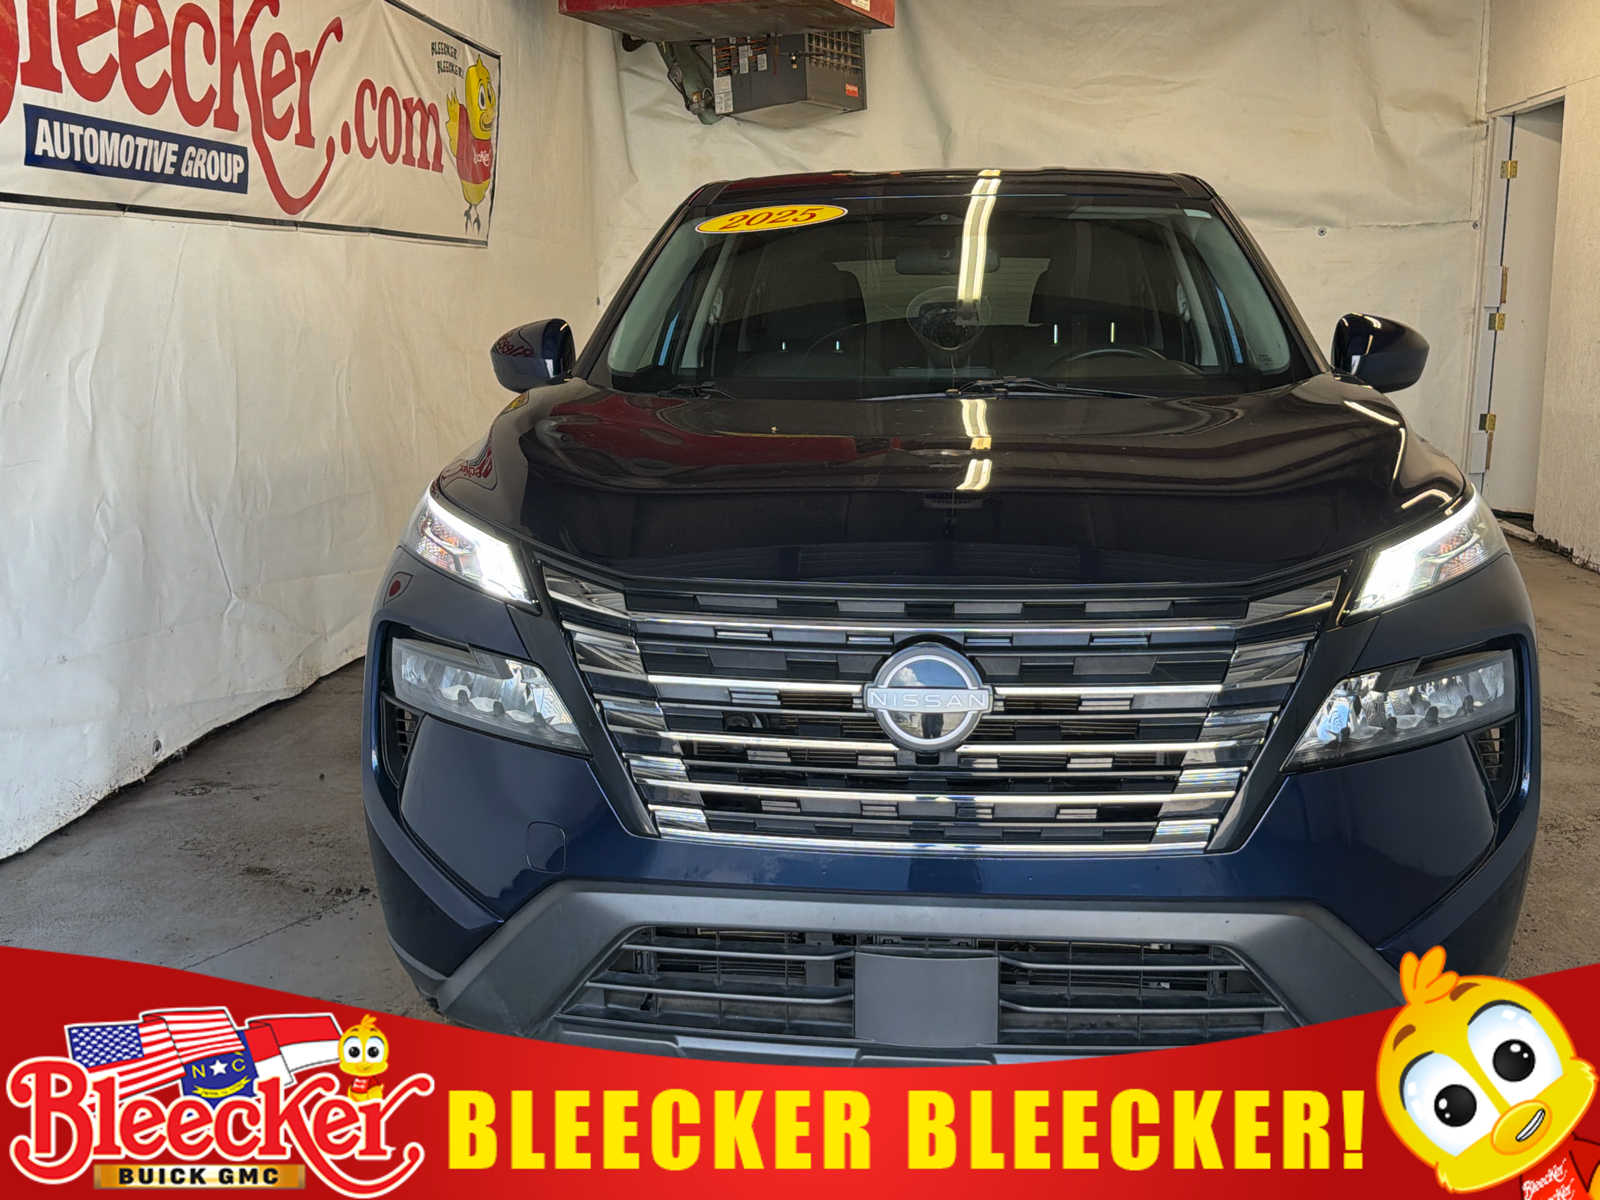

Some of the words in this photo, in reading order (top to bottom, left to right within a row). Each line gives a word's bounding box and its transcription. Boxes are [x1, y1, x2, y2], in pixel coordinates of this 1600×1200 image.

[0, 0, 445, 215] eecker.com
[34, 118, 178, 176] AUTOMOTIVE
[181, 147, 245, 185] GROUP
[718, 206, 825, 230] 2025
[870, 692, 986, 708] NISSAN
